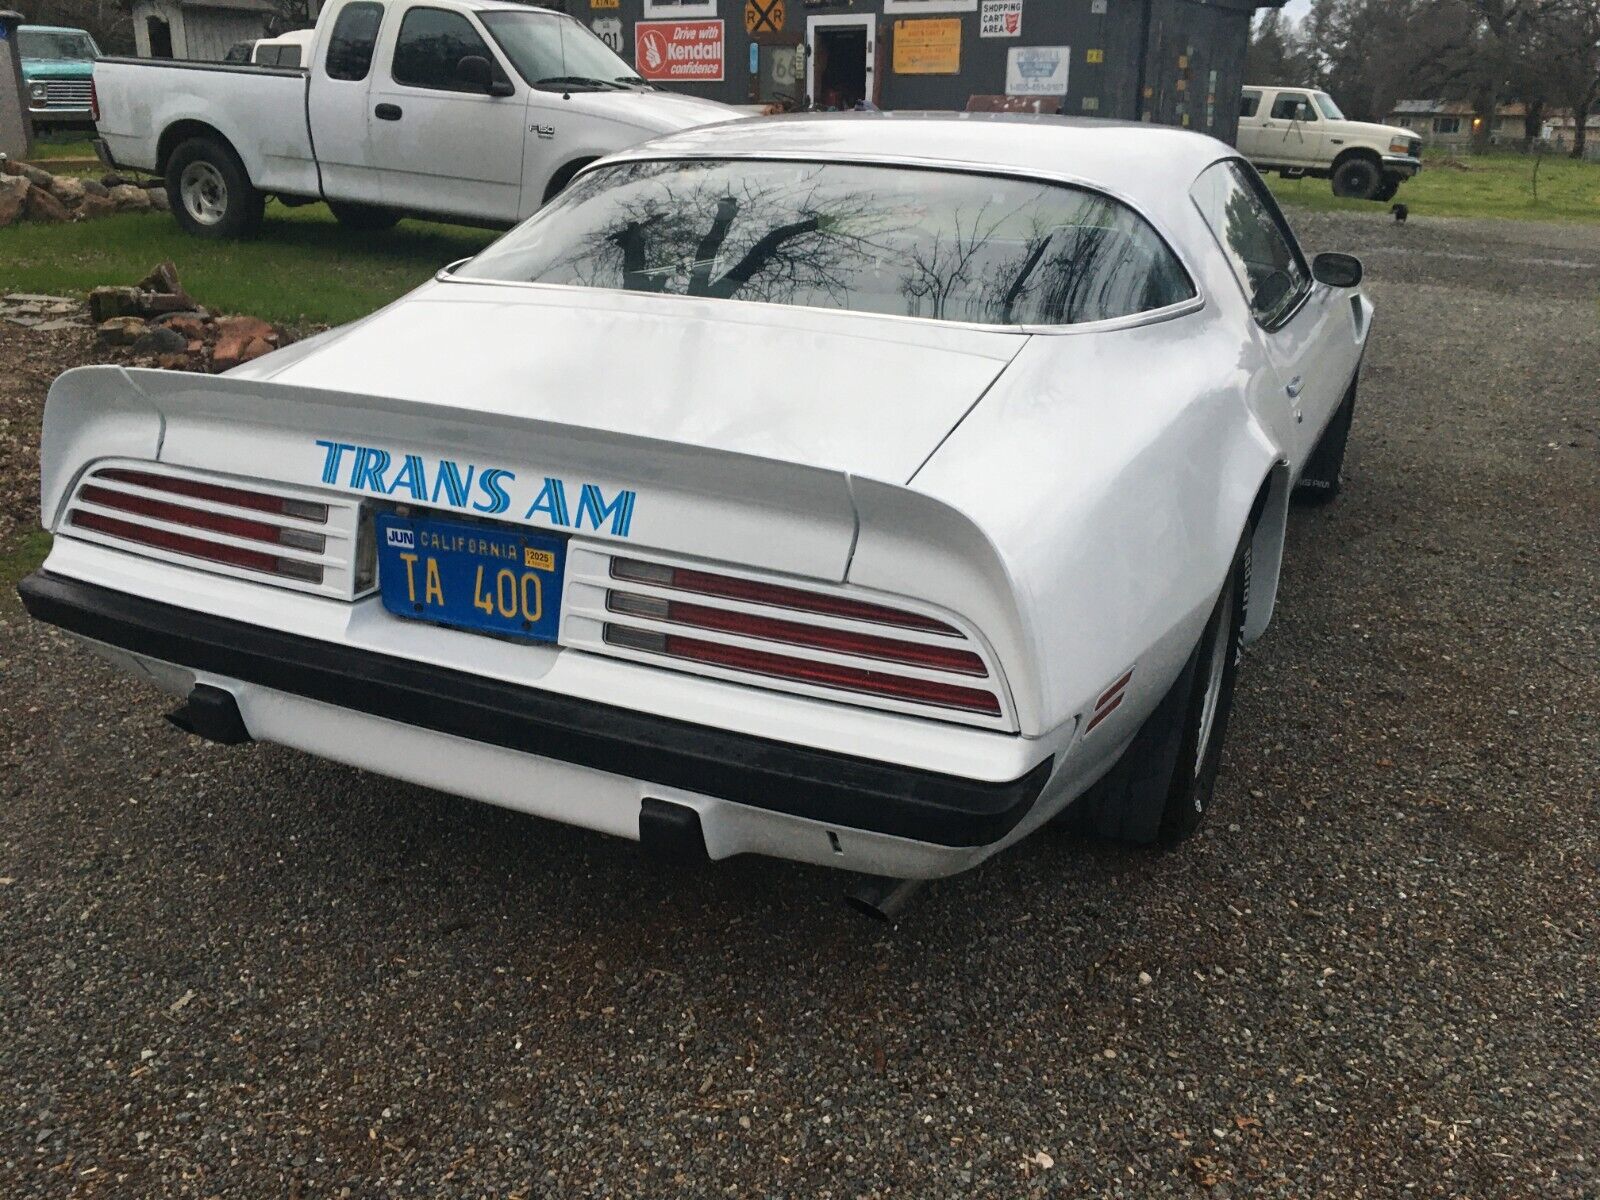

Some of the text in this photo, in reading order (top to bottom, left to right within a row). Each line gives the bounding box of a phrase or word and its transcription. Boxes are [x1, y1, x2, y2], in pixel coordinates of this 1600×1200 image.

[983, 3, 1021, 13] SHOPPING
[747, 9, 783, 24] R R
[983, 13, 1004, 23] CART
[673, 25, 719, 41] Drive with
[982, 24, 1004, 33] AREA
[597, 32, 617, 52] 01
[667, 41, 721, 62] Kendall
[670, 60, 719, 75] confidence
[315, 440, 636, 537] TRANS AM
[388, 530, 549, 562] JUN CALIFORNIA 2025
[399, 552, 543, 622] TA 400
